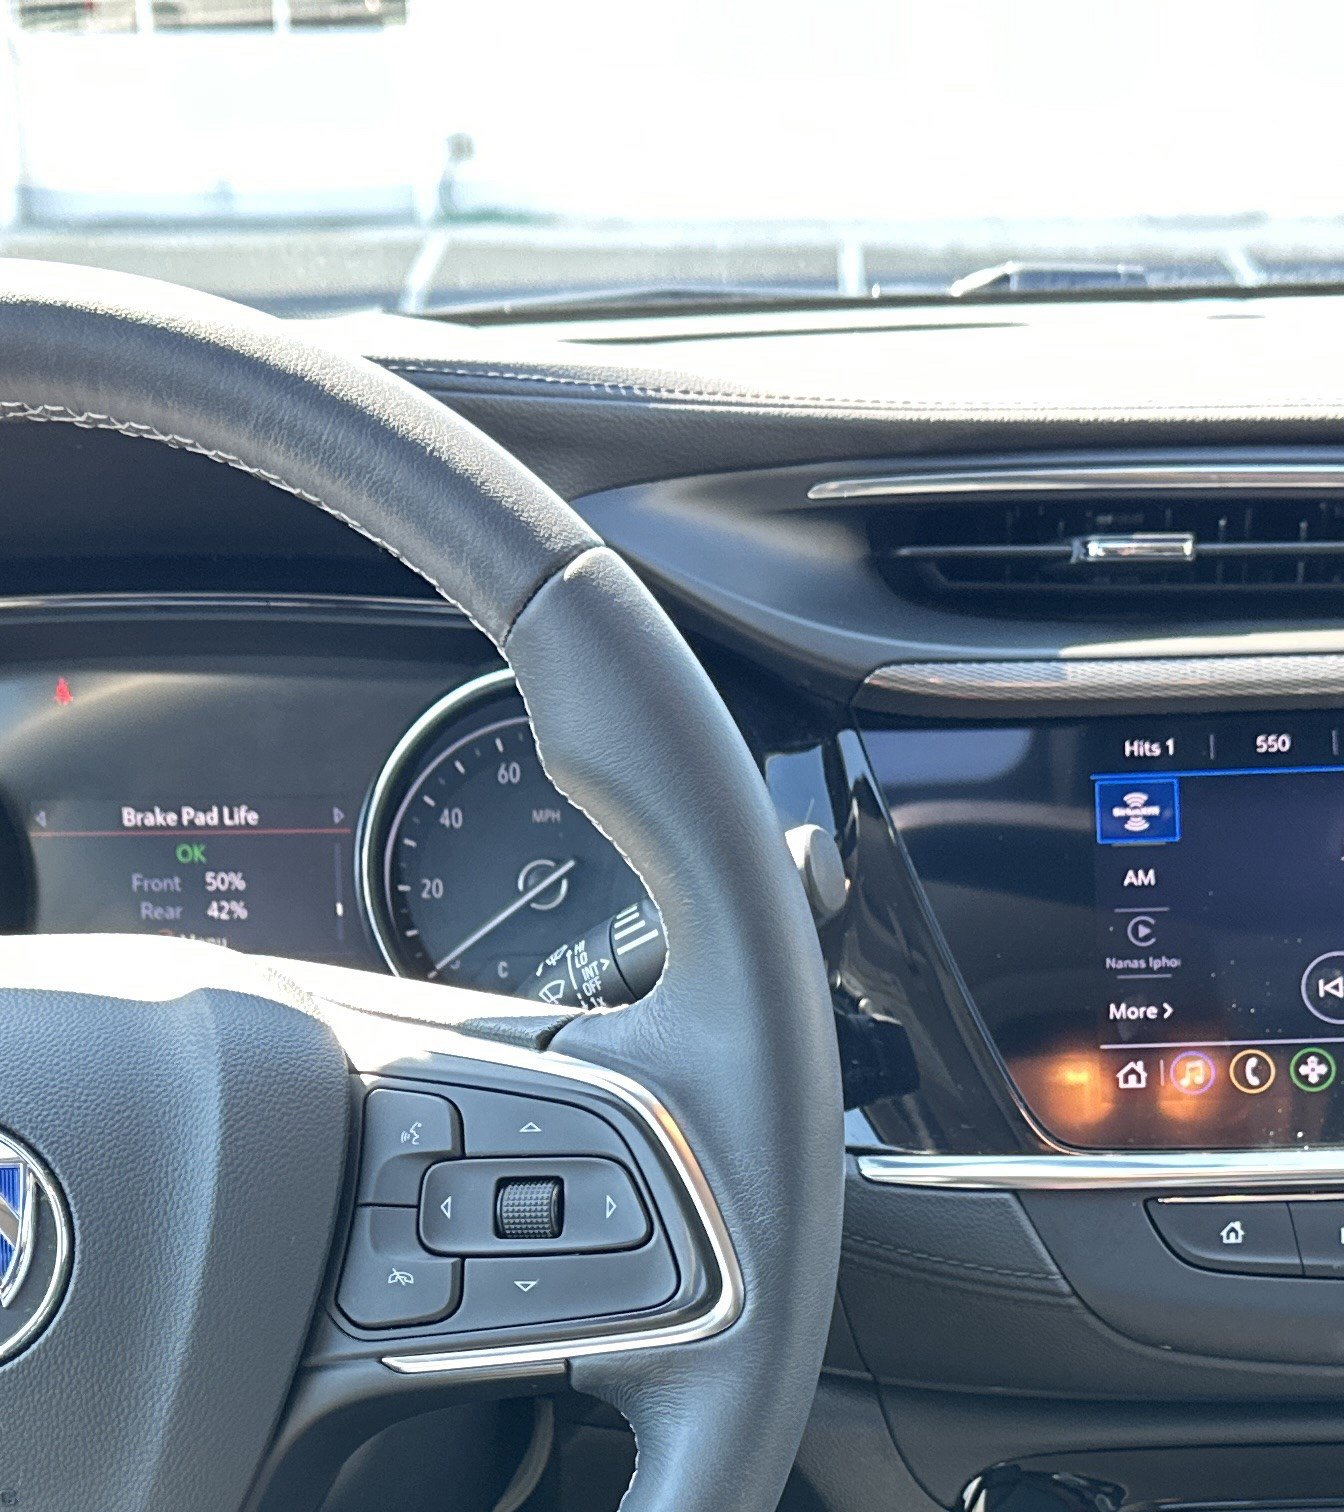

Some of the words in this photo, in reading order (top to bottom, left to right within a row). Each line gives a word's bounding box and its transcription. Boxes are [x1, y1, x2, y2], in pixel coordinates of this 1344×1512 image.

[1124, 738, 1162, 758] Hits
[1167, 738, 1174, 757] 1
[1255, 734, 1291, 754] 550
[498, 762, 520, 784] 60
[122, 807, 177, 828] Brake
[183, 807, 219, 826] Pad
[223, 805, 259, 826] Life
[439, 808, 463, 828] 40
[531, 809, 561, 823] MPH
[176, 844, 206, 864] OK
[131, 874, 181, 892] Front
[204, 872, 245, 891] 50%
[421, 878, 443, 898] 20
[1124, 869, 1156, 888] AM
[140, 903, 182, 920] Rear
[206, 900, 248, 920] 42%
[575, 940, 585, 955] HI
[575, 952, 588, 968] LO
[1105, 957, 1146, 969] Nanas
[582, 961, 599, 981] INT
[582, 976, 601, 996] OFF
[1109, 1003, 1158, 1020] More
